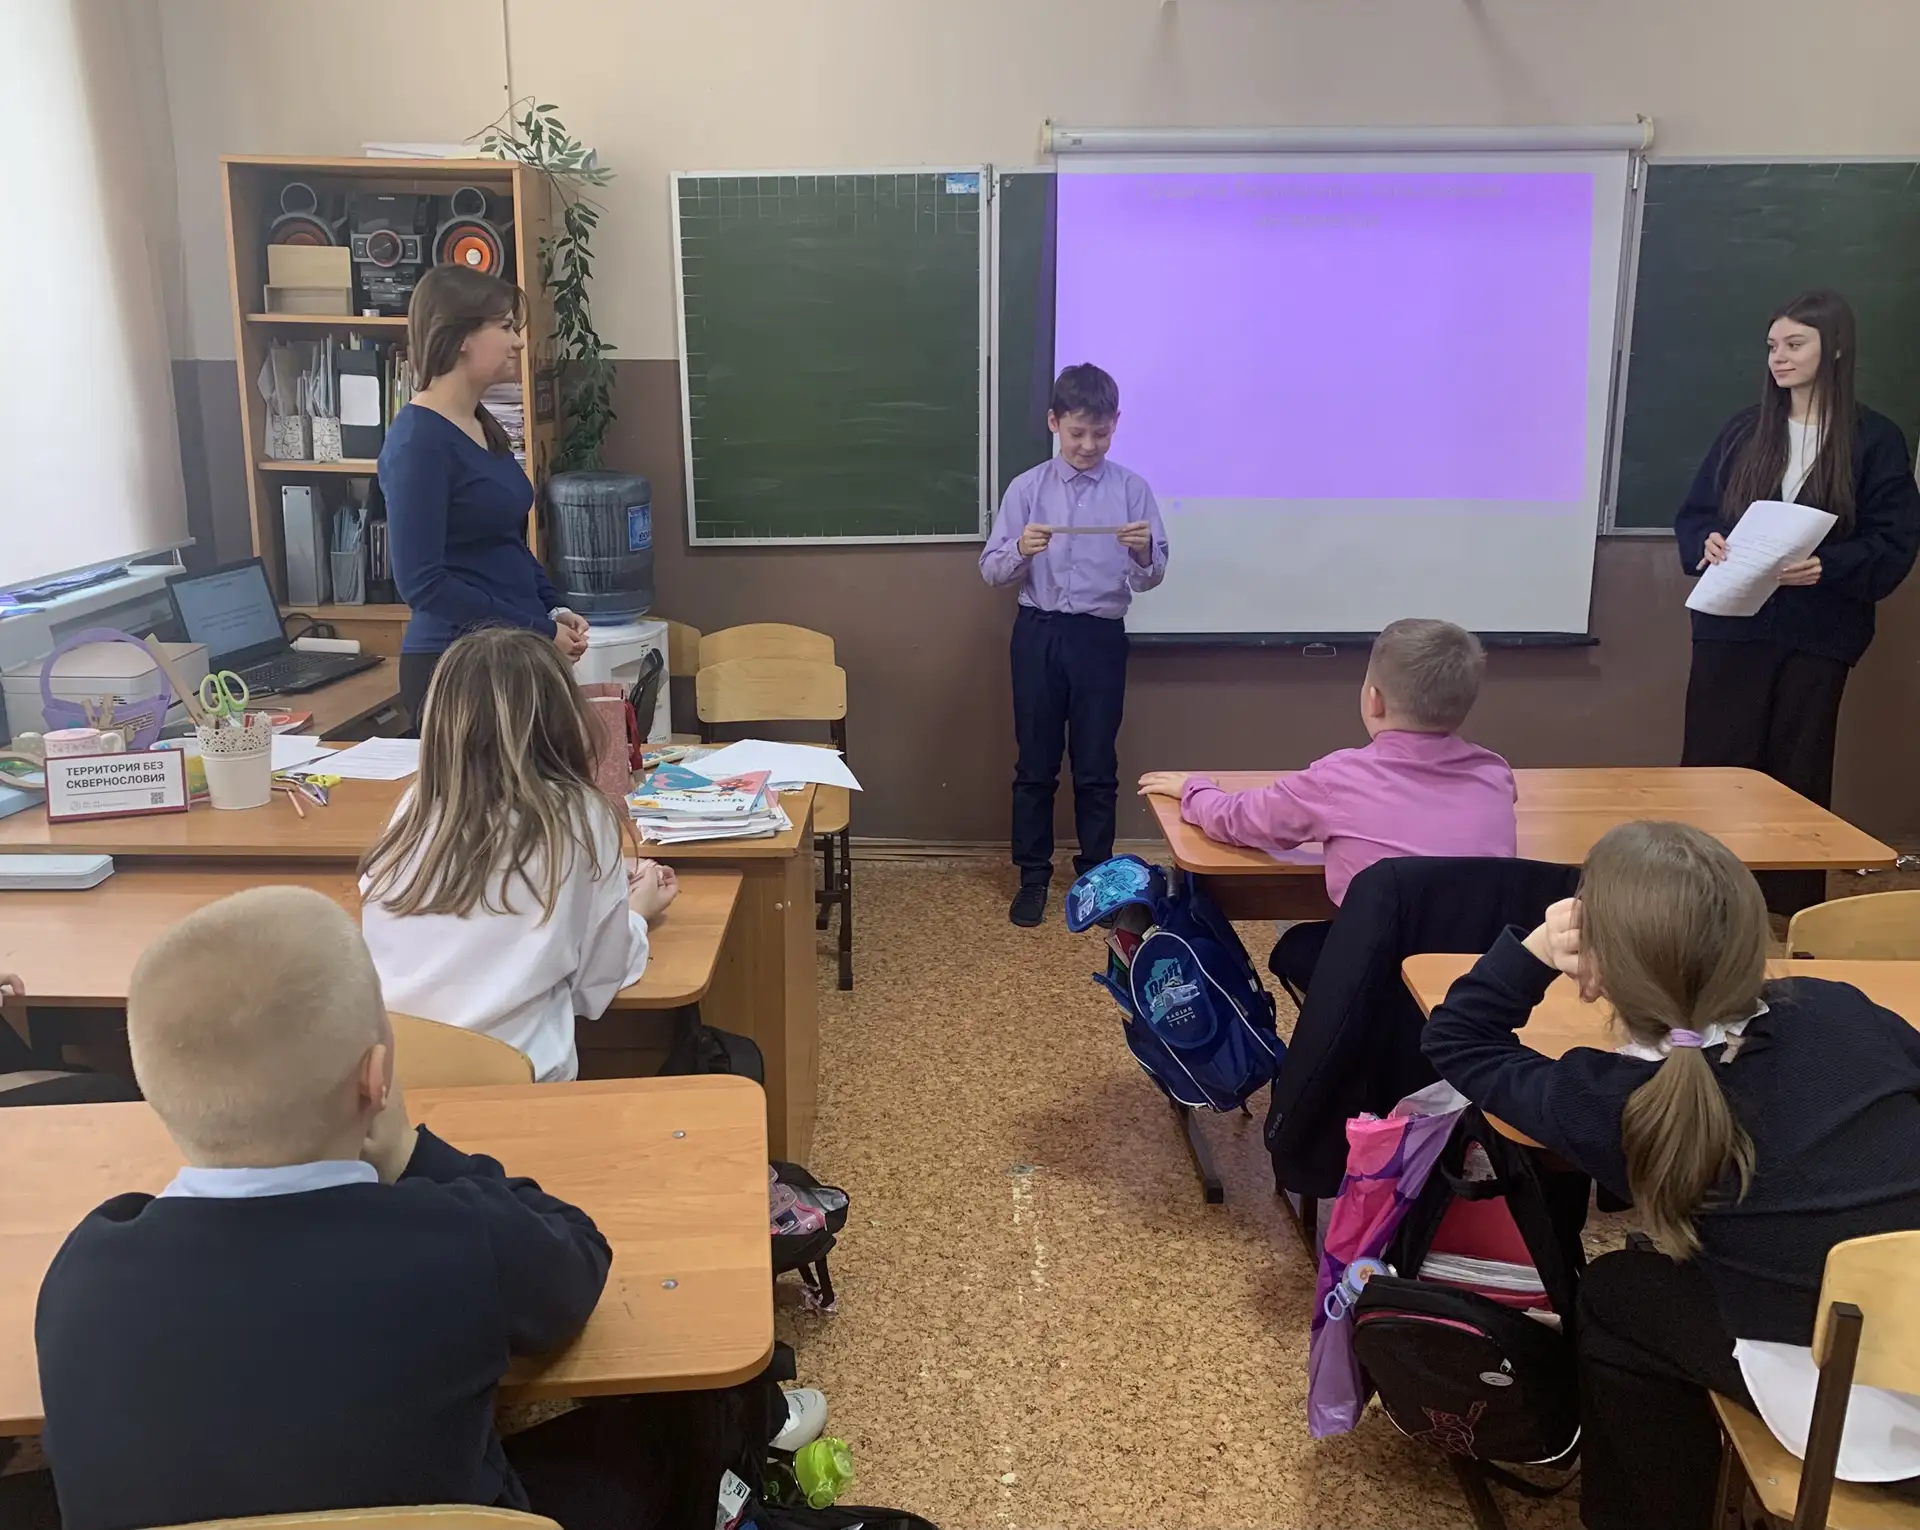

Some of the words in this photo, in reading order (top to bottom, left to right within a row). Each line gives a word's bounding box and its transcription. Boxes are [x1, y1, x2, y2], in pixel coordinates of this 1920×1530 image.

[66, 762, 141, 777] ТЕРРИТОРИЯ
[144, 760, 164, 771] БЕЗ
[66, 773, 165, 789] СКВЕРНОСЛОВИЯ
[1166, 1006, 1193, 1020] RACING
[1169, 1014, 1196, 1027] TEAM
